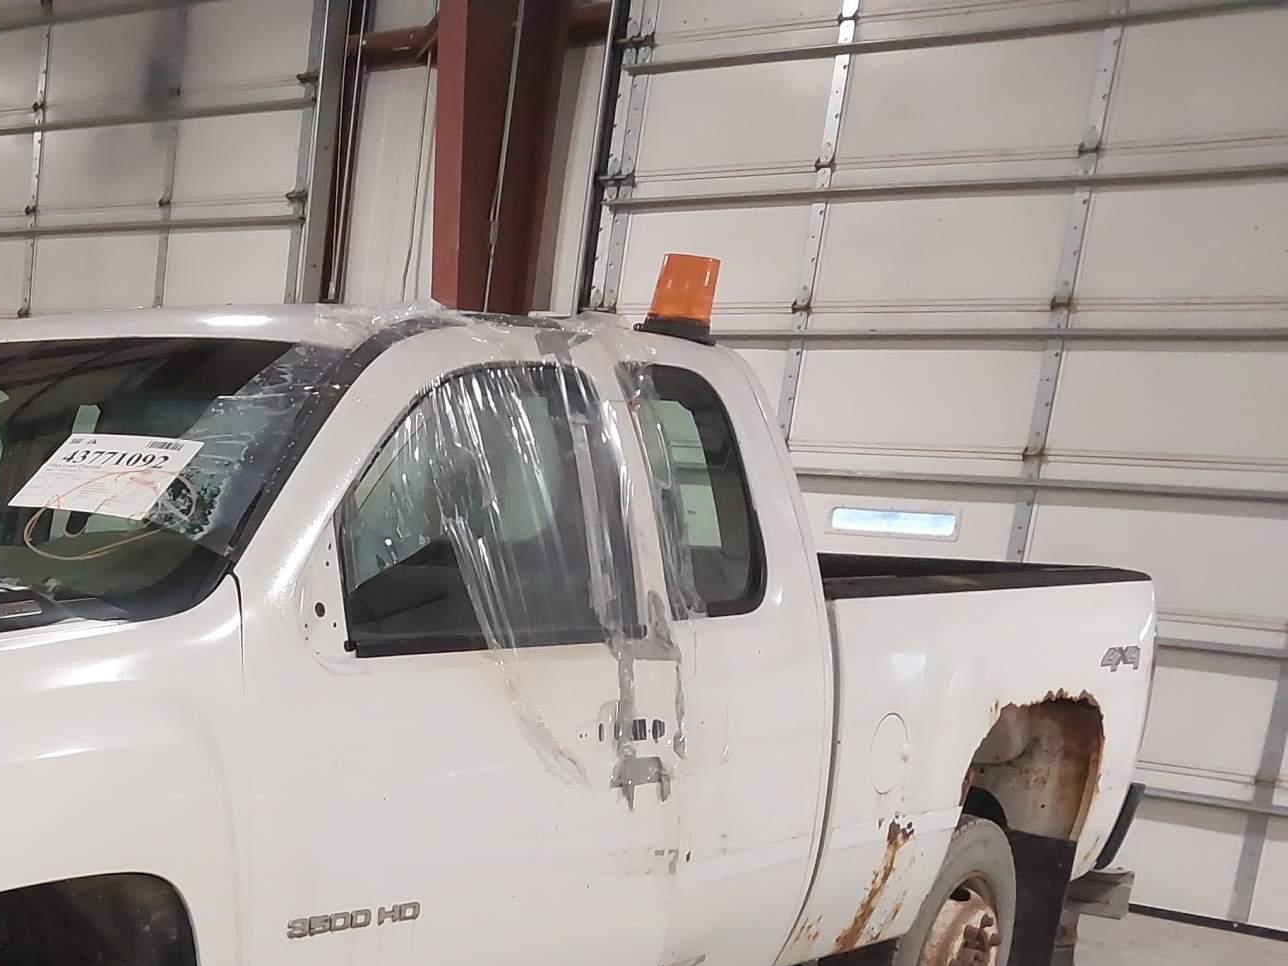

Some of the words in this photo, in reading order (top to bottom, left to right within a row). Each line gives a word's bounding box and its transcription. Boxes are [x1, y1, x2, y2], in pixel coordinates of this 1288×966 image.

[62, 449, 170, 469] 43771092
[287, 908, 372, 939] 3500
[377, 901, 421, 926] HD
